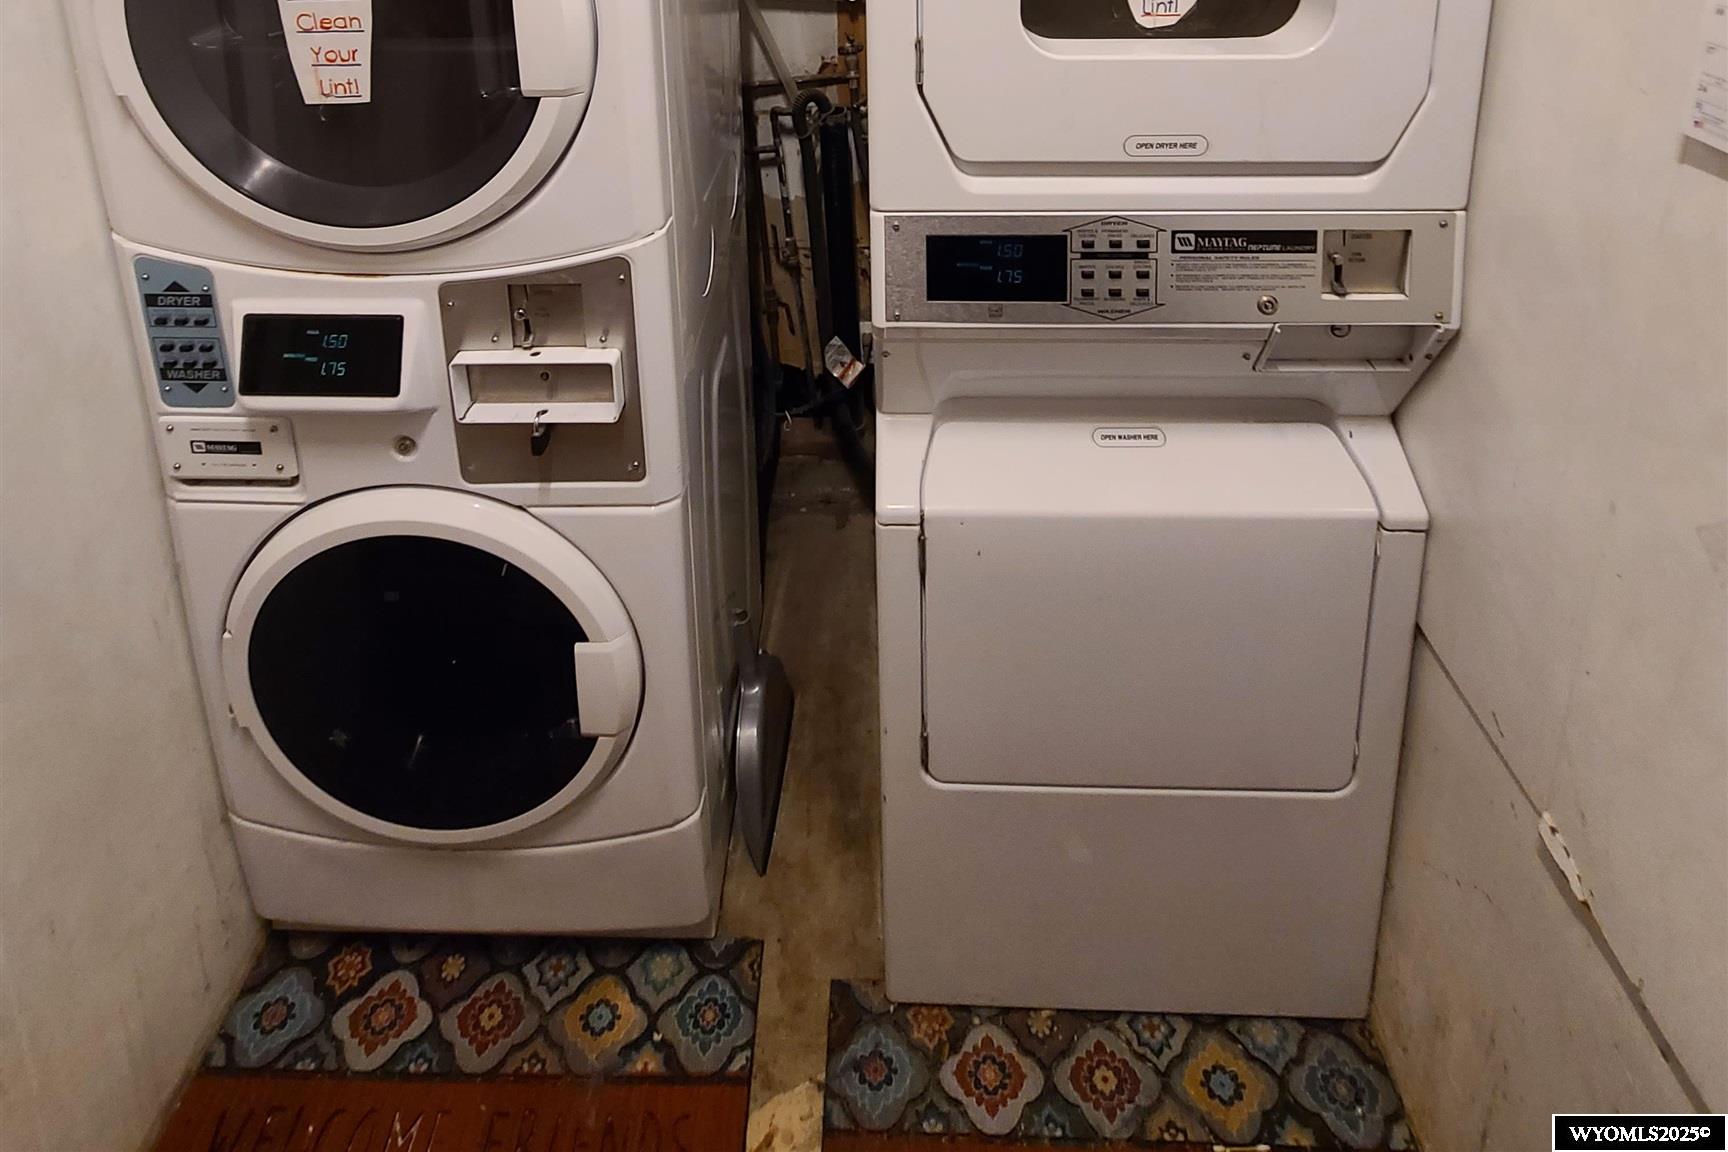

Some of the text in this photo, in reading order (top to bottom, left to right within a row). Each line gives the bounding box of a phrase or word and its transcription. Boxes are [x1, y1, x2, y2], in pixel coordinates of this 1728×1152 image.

[296, 12, 362, 30] Clean
[310, 47, 359, 64] Your
[319, 78, 360, 97] Lint!
[1135, 142, 1154, 150] OPEN
[1155, 142, 1178, 150] DRYER
[1198, 237, 1247, 247] MAYTAG
[157, 296, 201, 306] DRYER
[167, 369, 221, 380] WASHER
